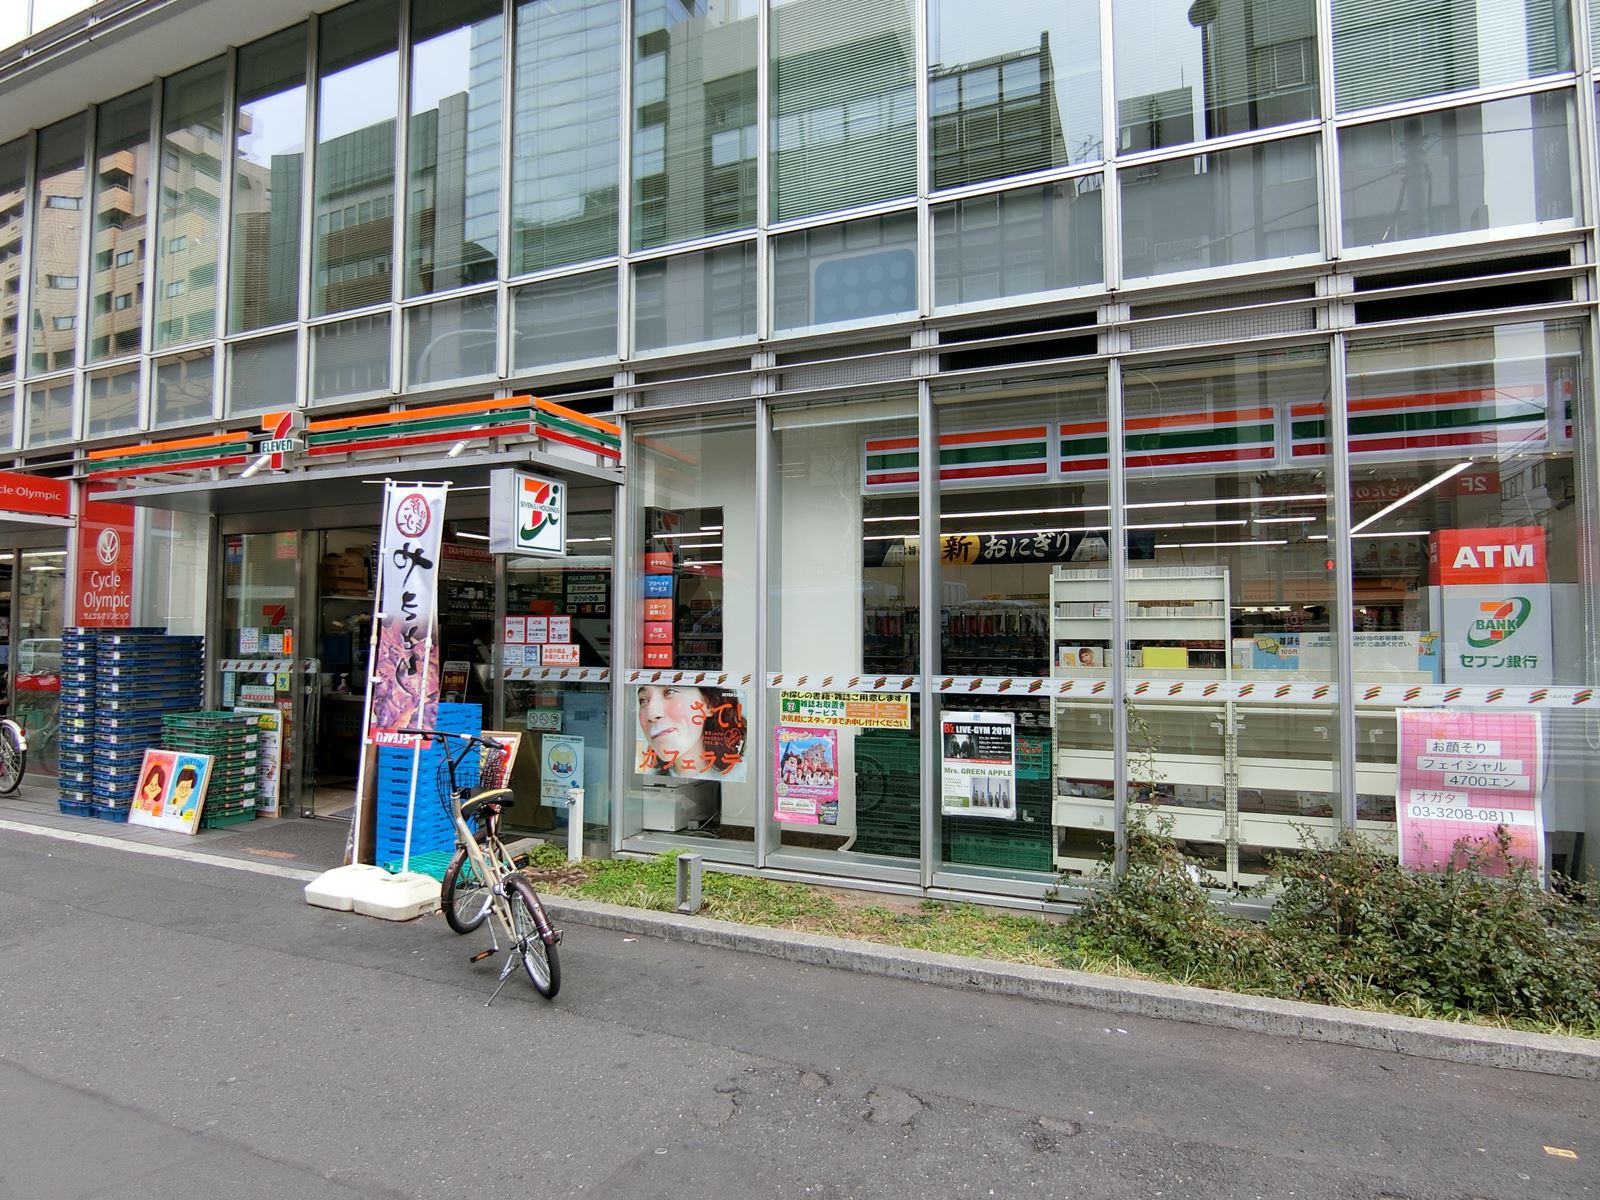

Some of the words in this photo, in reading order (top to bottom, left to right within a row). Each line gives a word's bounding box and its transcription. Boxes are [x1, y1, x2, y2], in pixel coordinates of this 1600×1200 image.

[16, 487, 61, 501] Olympic
[943, 536, 973, 562] 新
[984, 532, 1070, 559] おにぎり
[1452, 544, 1534, 569] ATM
[91, 571, 121, 592] Cycle
[84, 591, 130, 611] Olympic
[1476, 620, 1519, 631] BANK
[1460, 654, 1538, 669] セブン銀行
[807, 709, 838, 717] サービス
[956, 725, 990, 734] LIVE-GYM
[991, 726, 1011, 735] 2019
[1433, 741, 1487, 753] お顔そり
[640, 746, 743, 775] カフェラテ
[1423, 758, 1507, 773] フェイシャル
[1449, 775, 1516, 788] 4700エン
[1416, 792, 1456, 804] オガタ
[1412, 806, 1514, 822] 03-3208-0811
